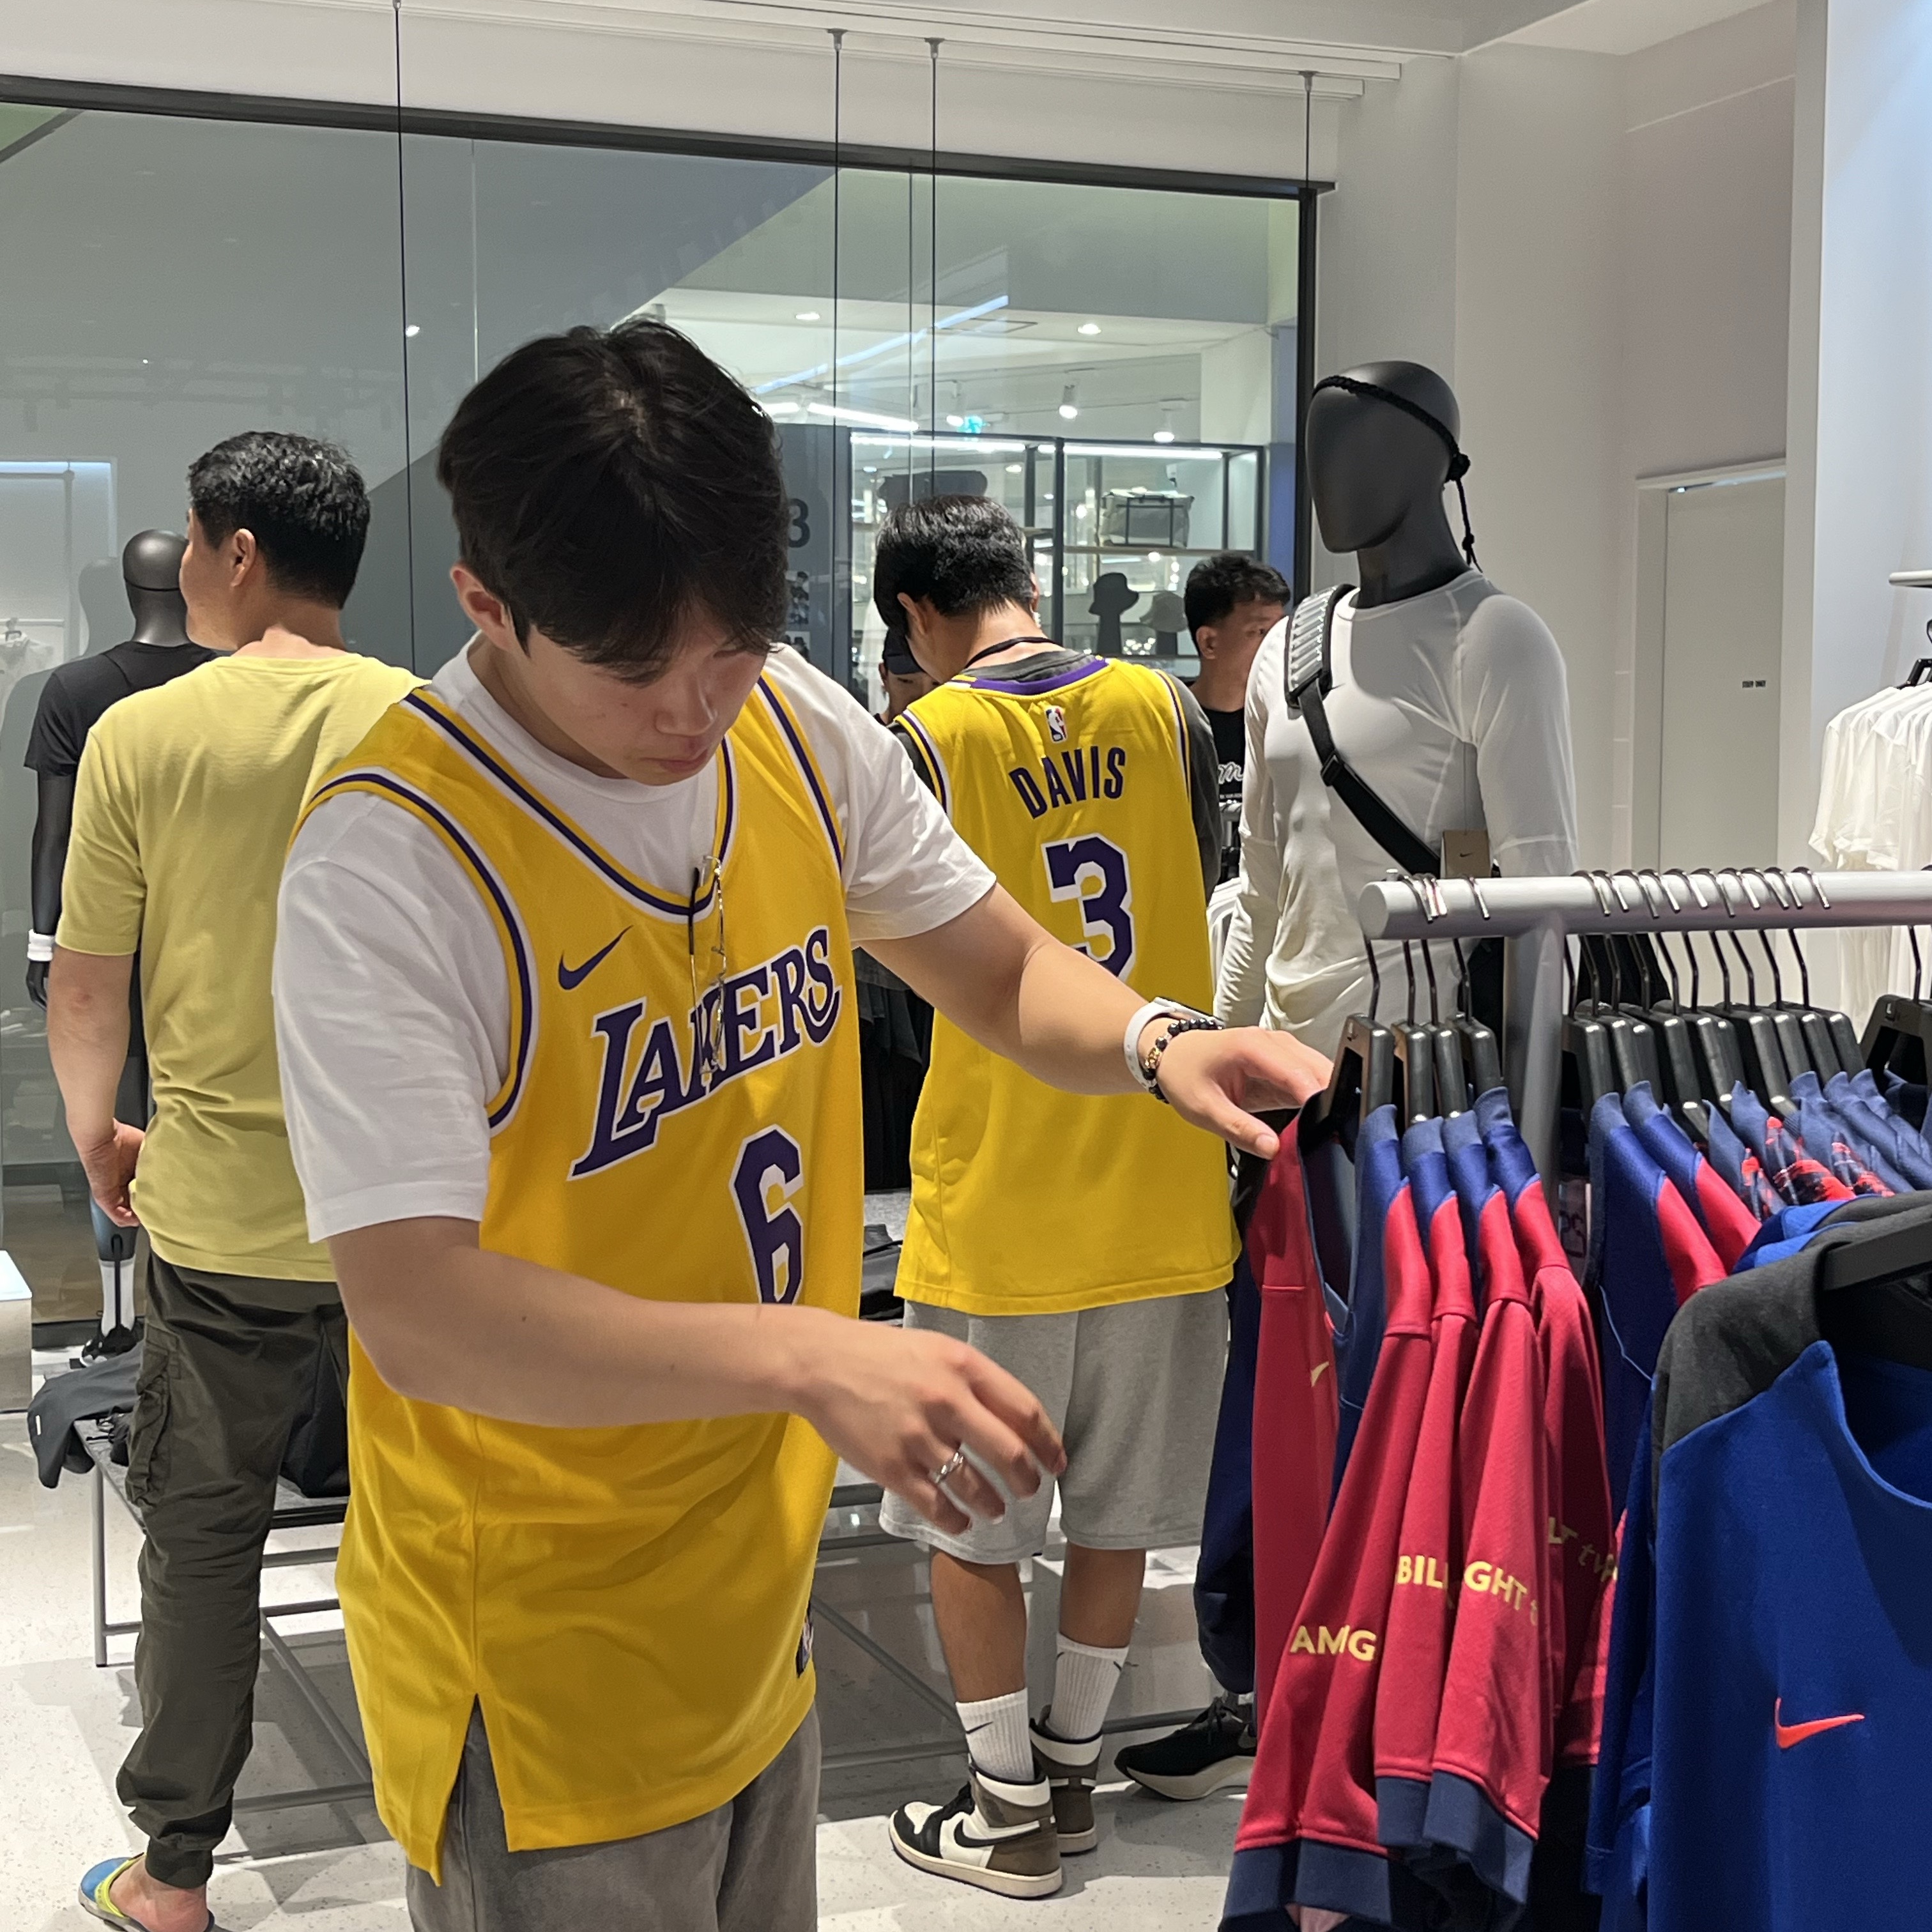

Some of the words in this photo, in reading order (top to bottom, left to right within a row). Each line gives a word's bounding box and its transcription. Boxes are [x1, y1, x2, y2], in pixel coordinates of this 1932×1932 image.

[1008, 746, 1126, 820] DAVIS
[1041, 832, 1136, 983] 3
[567, 925, 843, 1181] LAKERS
[728, 1123, 804, 1306] 6
[1289, 1624, 1377, 1662] AMG
